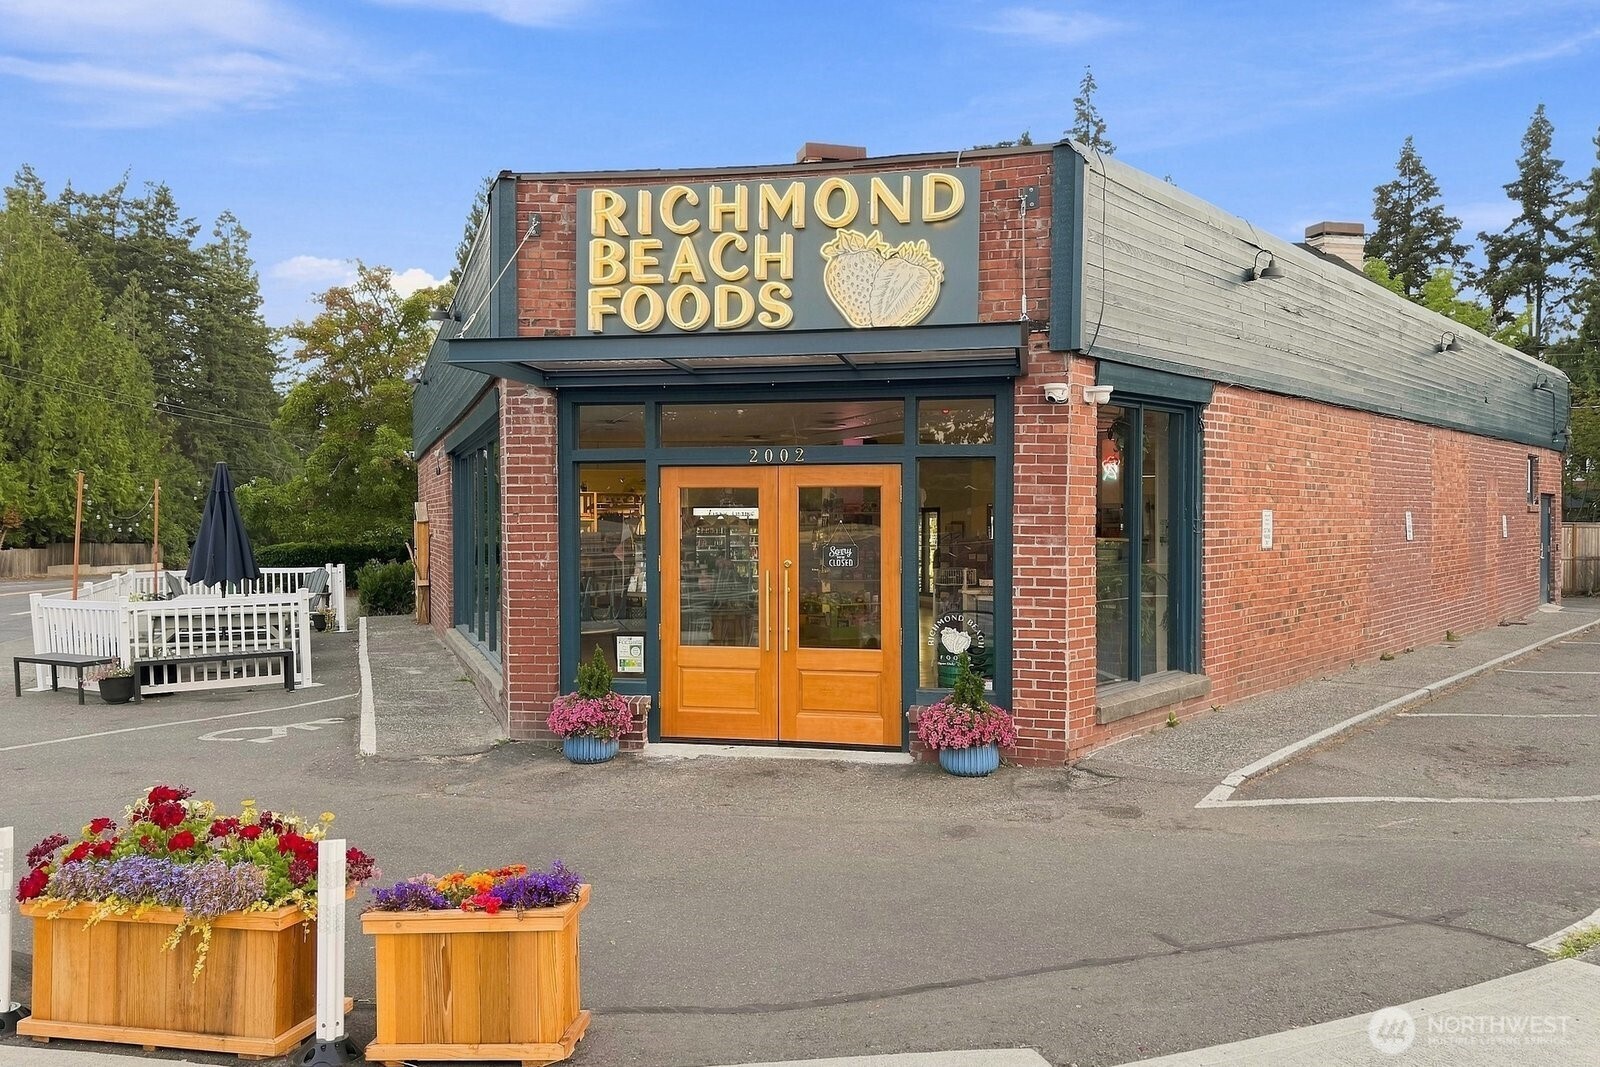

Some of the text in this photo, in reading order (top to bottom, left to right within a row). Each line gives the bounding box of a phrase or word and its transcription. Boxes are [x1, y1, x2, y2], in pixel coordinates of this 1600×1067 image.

[591, 173, 965, 237] RICHMOND
[588, 232, 793, 285] BEACH
[587, 281, 793, 333] FOODS
[749, 448, 804, 463] 2002
[828, 545, 852, 557] Sorry
[828, 558, 853, 567] CLOSED
[927, 614, 985, 648] RICHMOND BEACH
